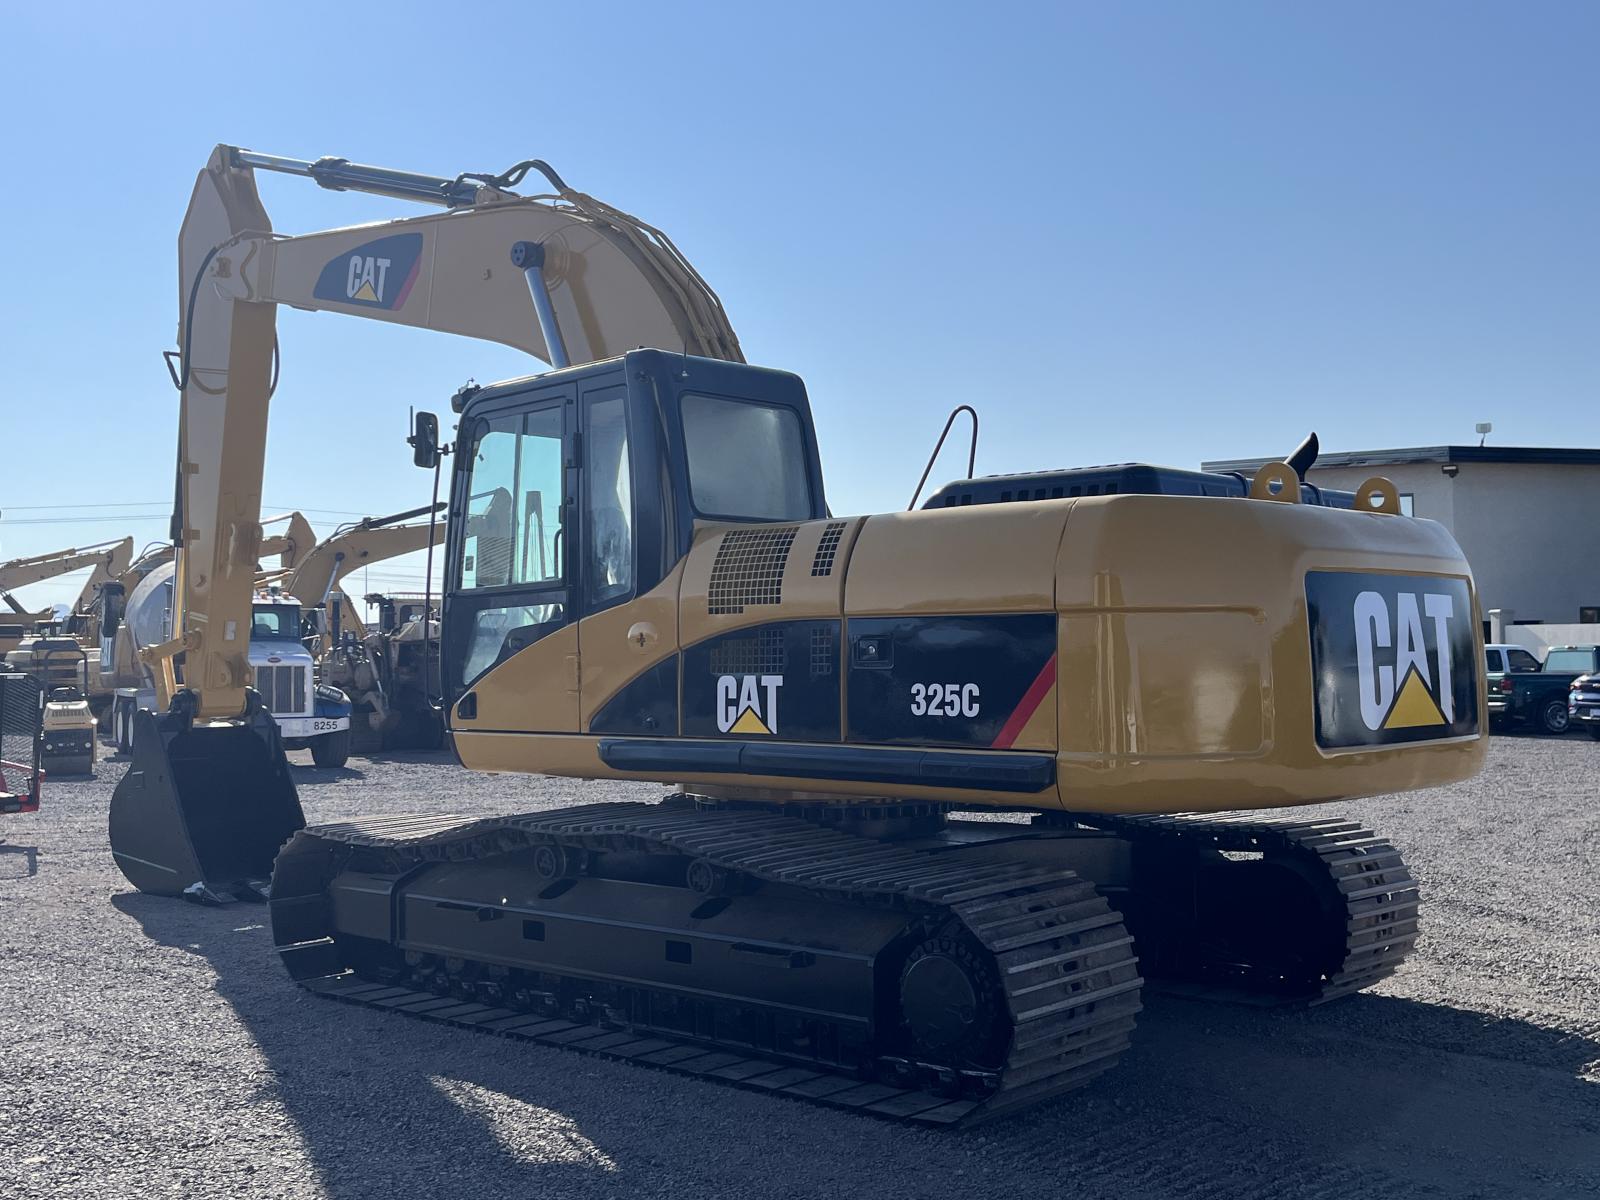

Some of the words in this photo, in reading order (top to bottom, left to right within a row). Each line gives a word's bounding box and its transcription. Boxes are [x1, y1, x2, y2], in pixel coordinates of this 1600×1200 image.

[346, 255, 391, 303] CAT
[1353, 591, 1454, 731] CAT
[716, 674, 783, 735] CAT
[910, 682, 980, 718] 325C
[313, 720, 338, 731] 8255
